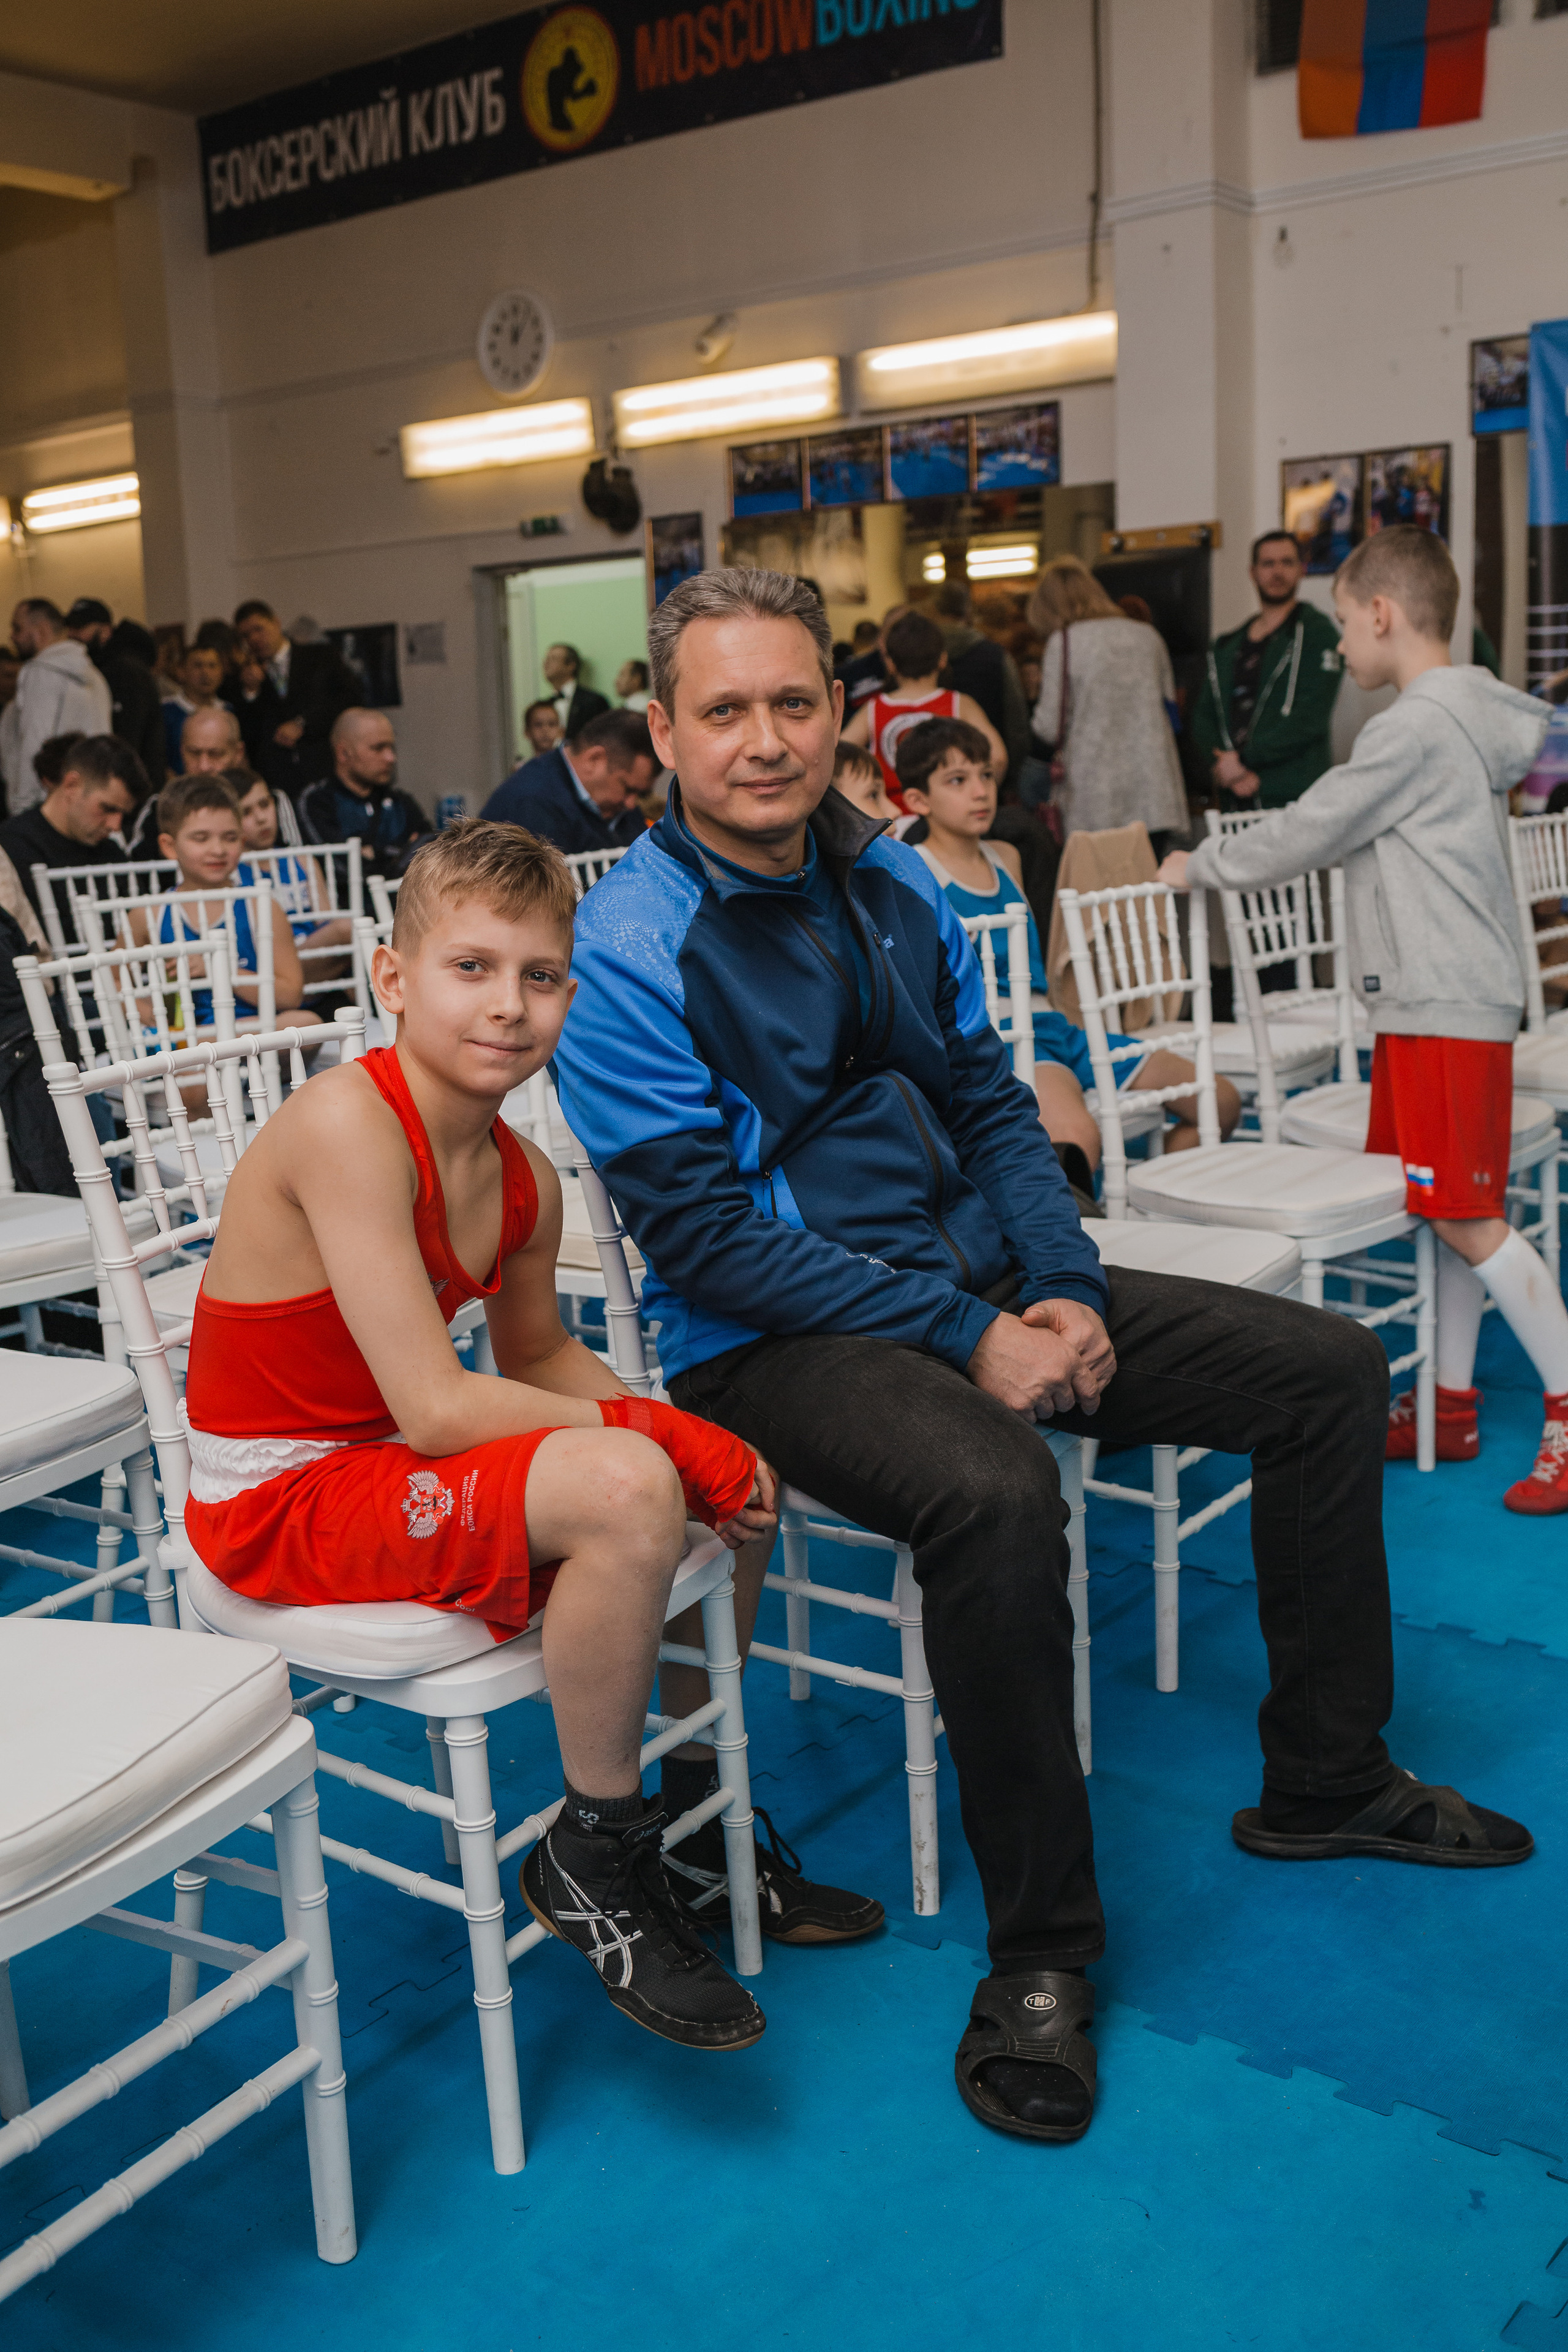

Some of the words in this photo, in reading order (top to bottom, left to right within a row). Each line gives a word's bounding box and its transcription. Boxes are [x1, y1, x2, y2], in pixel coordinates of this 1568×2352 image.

[208, 86, 402, 213] БОКСЕРСКИЙ
[408, 66, 507, 156] КЛУБ
[461, 1476, 470, 1526] ФЕДЕРАЦИЯ
[467, 1470, 478, 1502] РОССИИ
[467, 1504, 475, 1532] БОКСА
